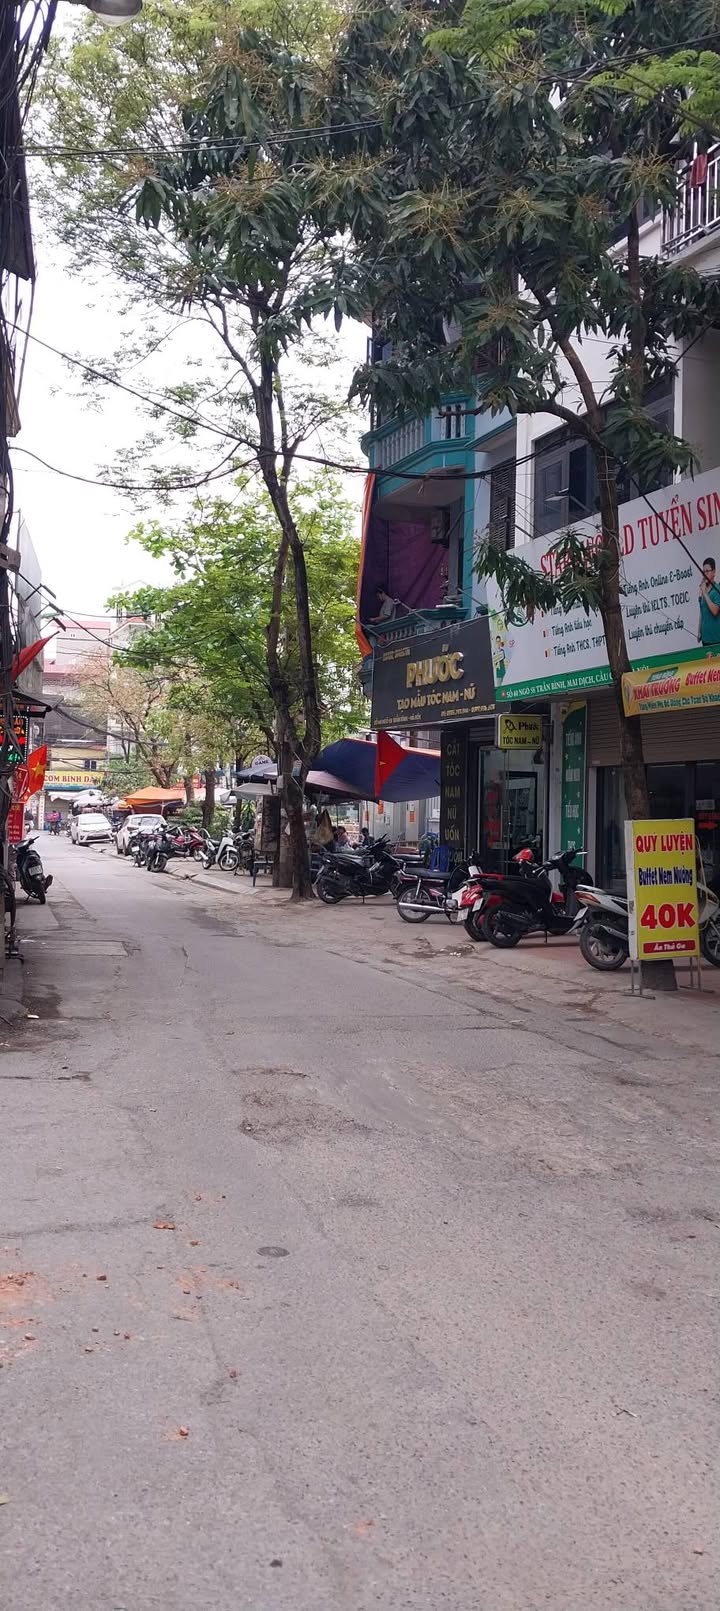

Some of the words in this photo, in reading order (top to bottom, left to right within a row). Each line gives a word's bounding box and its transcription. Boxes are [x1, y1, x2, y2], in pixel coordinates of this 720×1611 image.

[637, 494, 693, 550] TUYỂN
[623, 581, 638, 596] Tiếng
[638, 579, 650, 592] Anh
[650, 574, 668, 588] Online
[669, 565, 693, 582] E-Boost
[626, 604, 642, 619] Luyện
[642, 601, 651, 613] thi
[670, 591, 690, 607] TOEIC
[552, 624, 564, 637] Tiếng
[564, 622, 574, 633] Anh
[583, 618, 592, 631] học
[628, 627, 645, 641] Luyện
[645, 624, 653, 636] thi
[554, 643, 566, 657] Tiếng
[566, 642, 576, 653] Anh
[406, 644, 465, 688] PHƯỚC
[567, 678, 578, 687] MAI
[595, 670, 608, 682] CẦU
[427, 689, 442, 705] TÓC
[442, 690, 460, 704] NAM
[503, 736, 513, 744] TÓC
[514, 736, 527, 744] NAM
[446, 763, 460, 777] TÓC
[445, 785, 461, 798] NAM
[638, 867, 658, 886] Buffet
[658, 866, 673, 885] Nem
[640, 902, 696, 930] 40K
